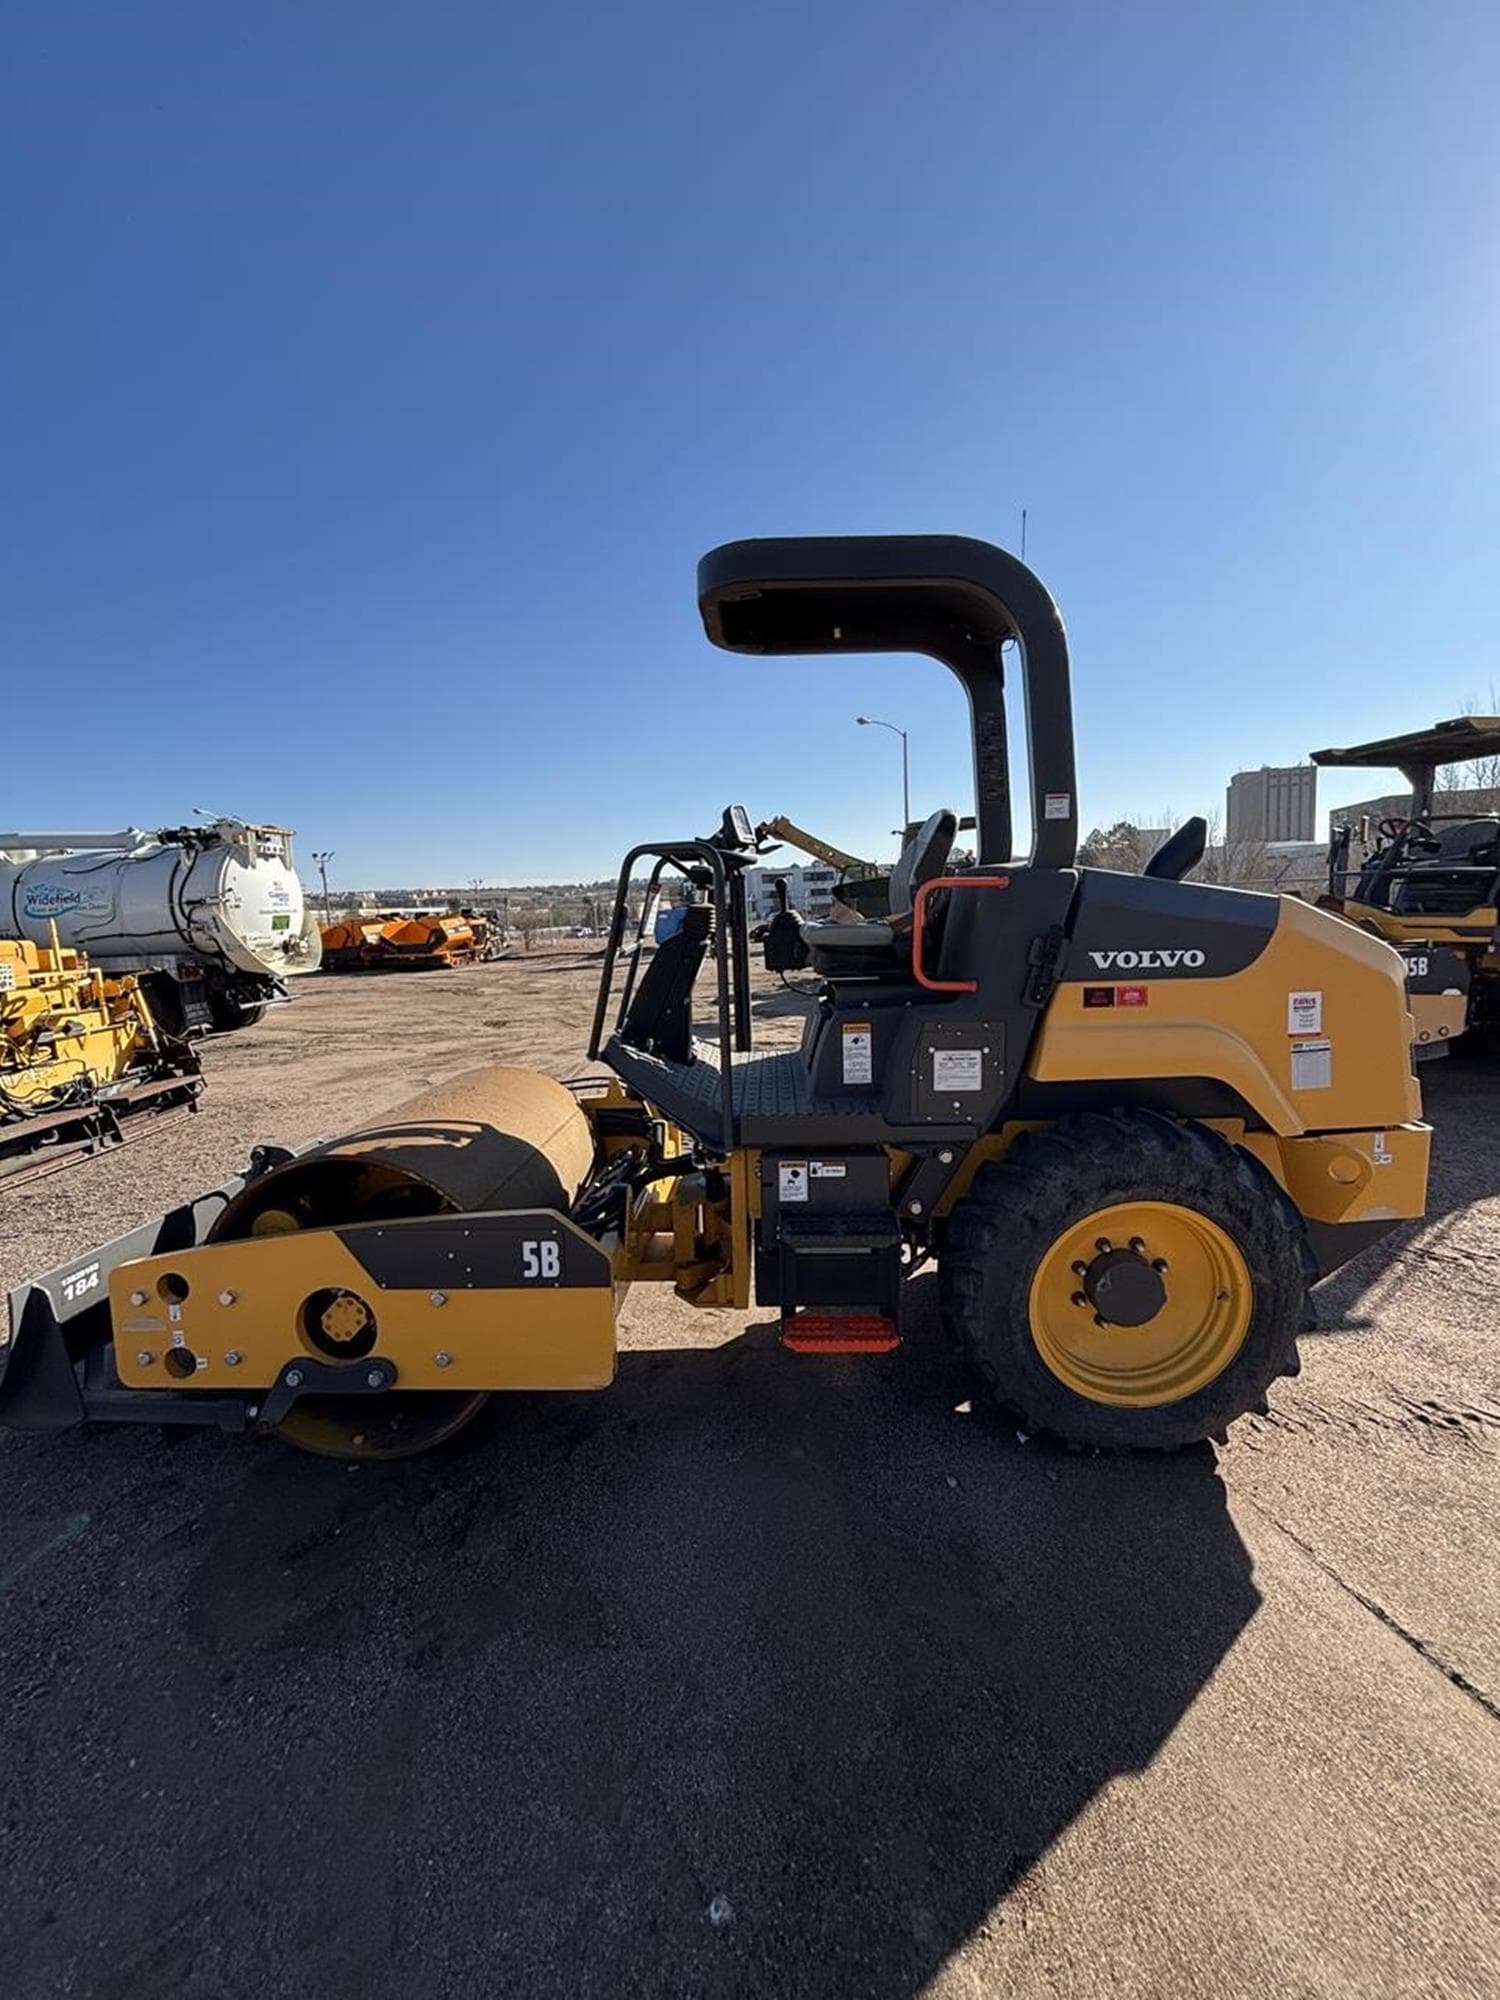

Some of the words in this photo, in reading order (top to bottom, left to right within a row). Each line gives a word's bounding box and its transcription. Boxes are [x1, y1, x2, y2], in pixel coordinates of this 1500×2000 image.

[27, 891, 81, 905] Widefield
[1088, 949, 1206, 969] VOLVO
[1404, 957, 1429, 976] 5B
[522, 1240, 561, 1278] 5B
[63, 1271, 99, 1300] 184
